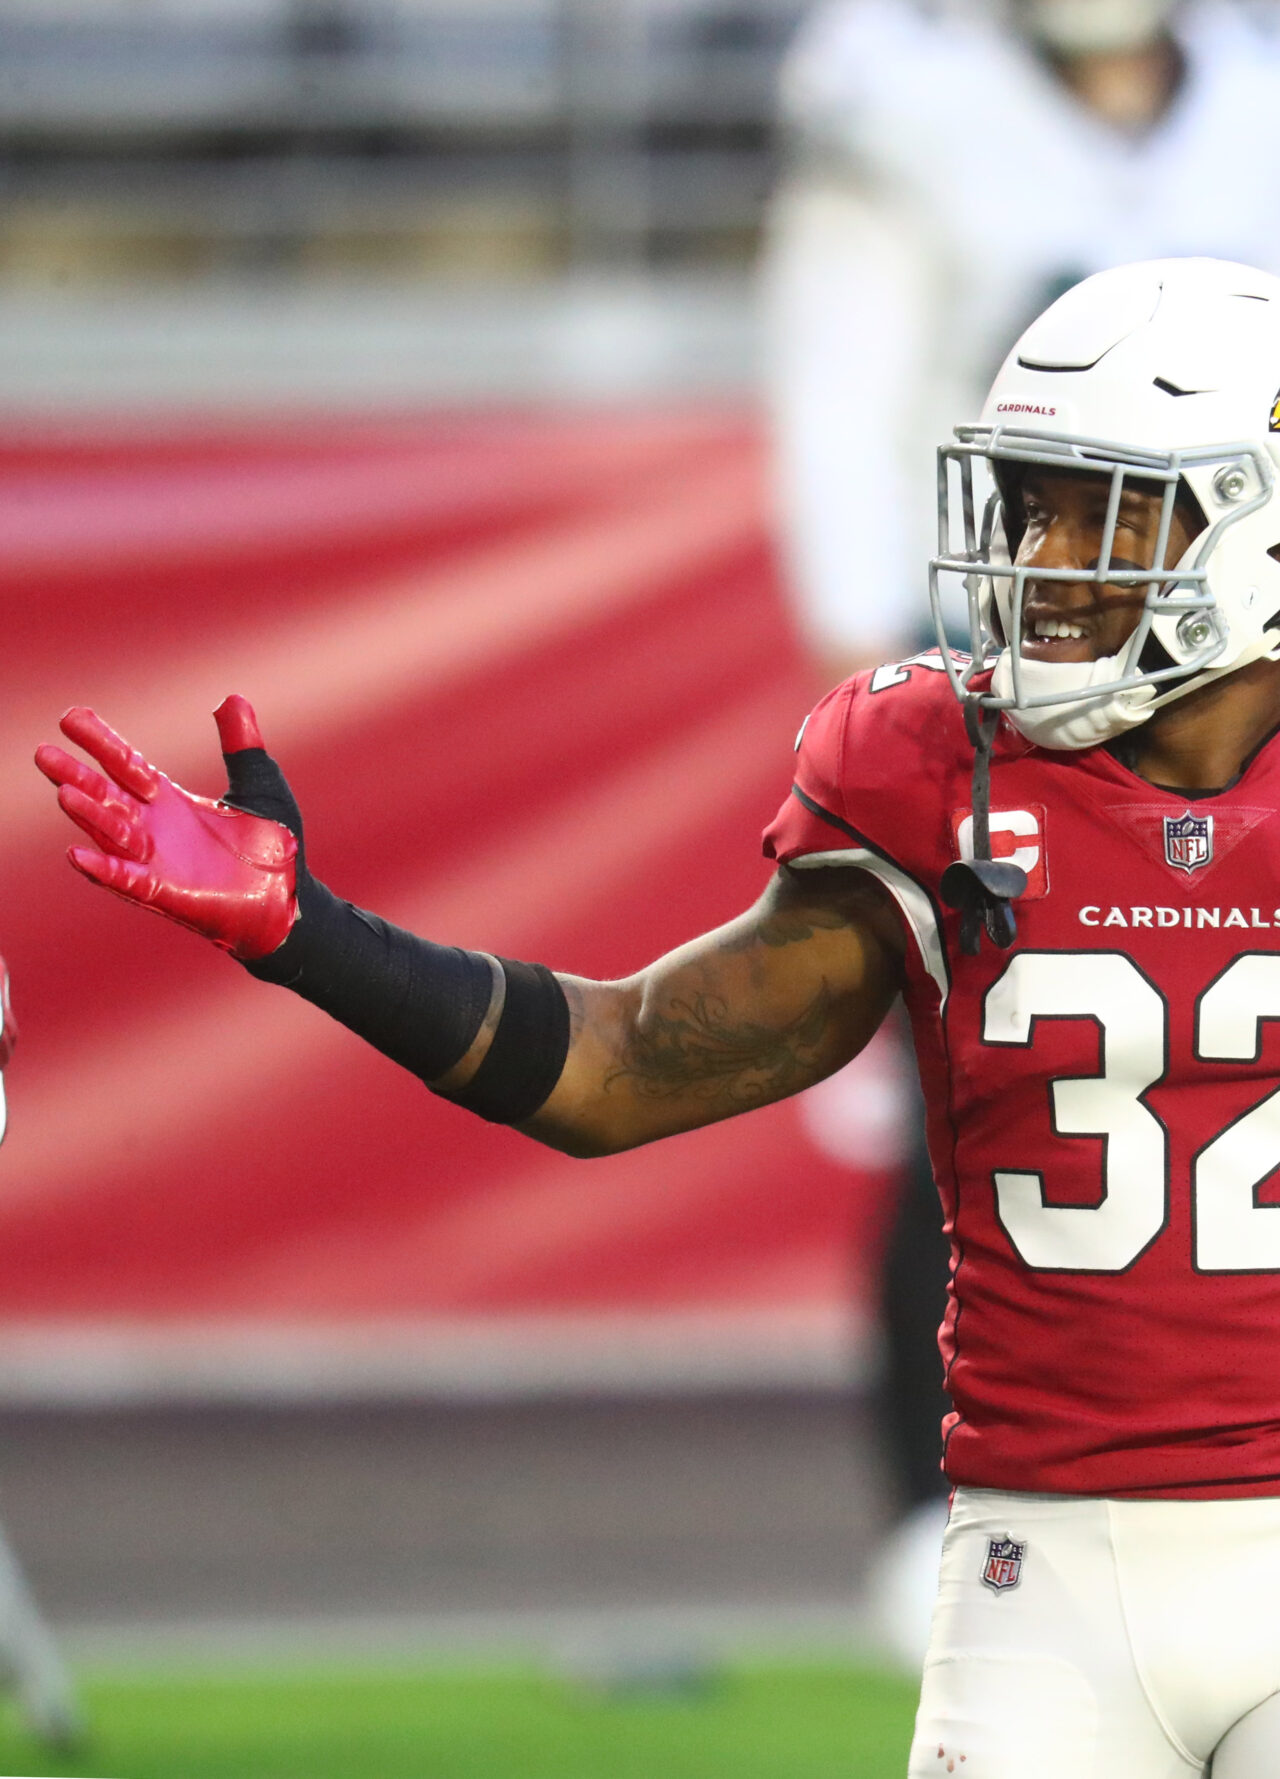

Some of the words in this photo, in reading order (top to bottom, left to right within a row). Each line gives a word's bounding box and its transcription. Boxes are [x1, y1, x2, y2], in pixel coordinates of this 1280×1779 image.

[996, 403, 1056, 416] CARDINALS
[1171, 838, 1206, 863] NFL
[986, 1557, 1017, 1585] NFL
